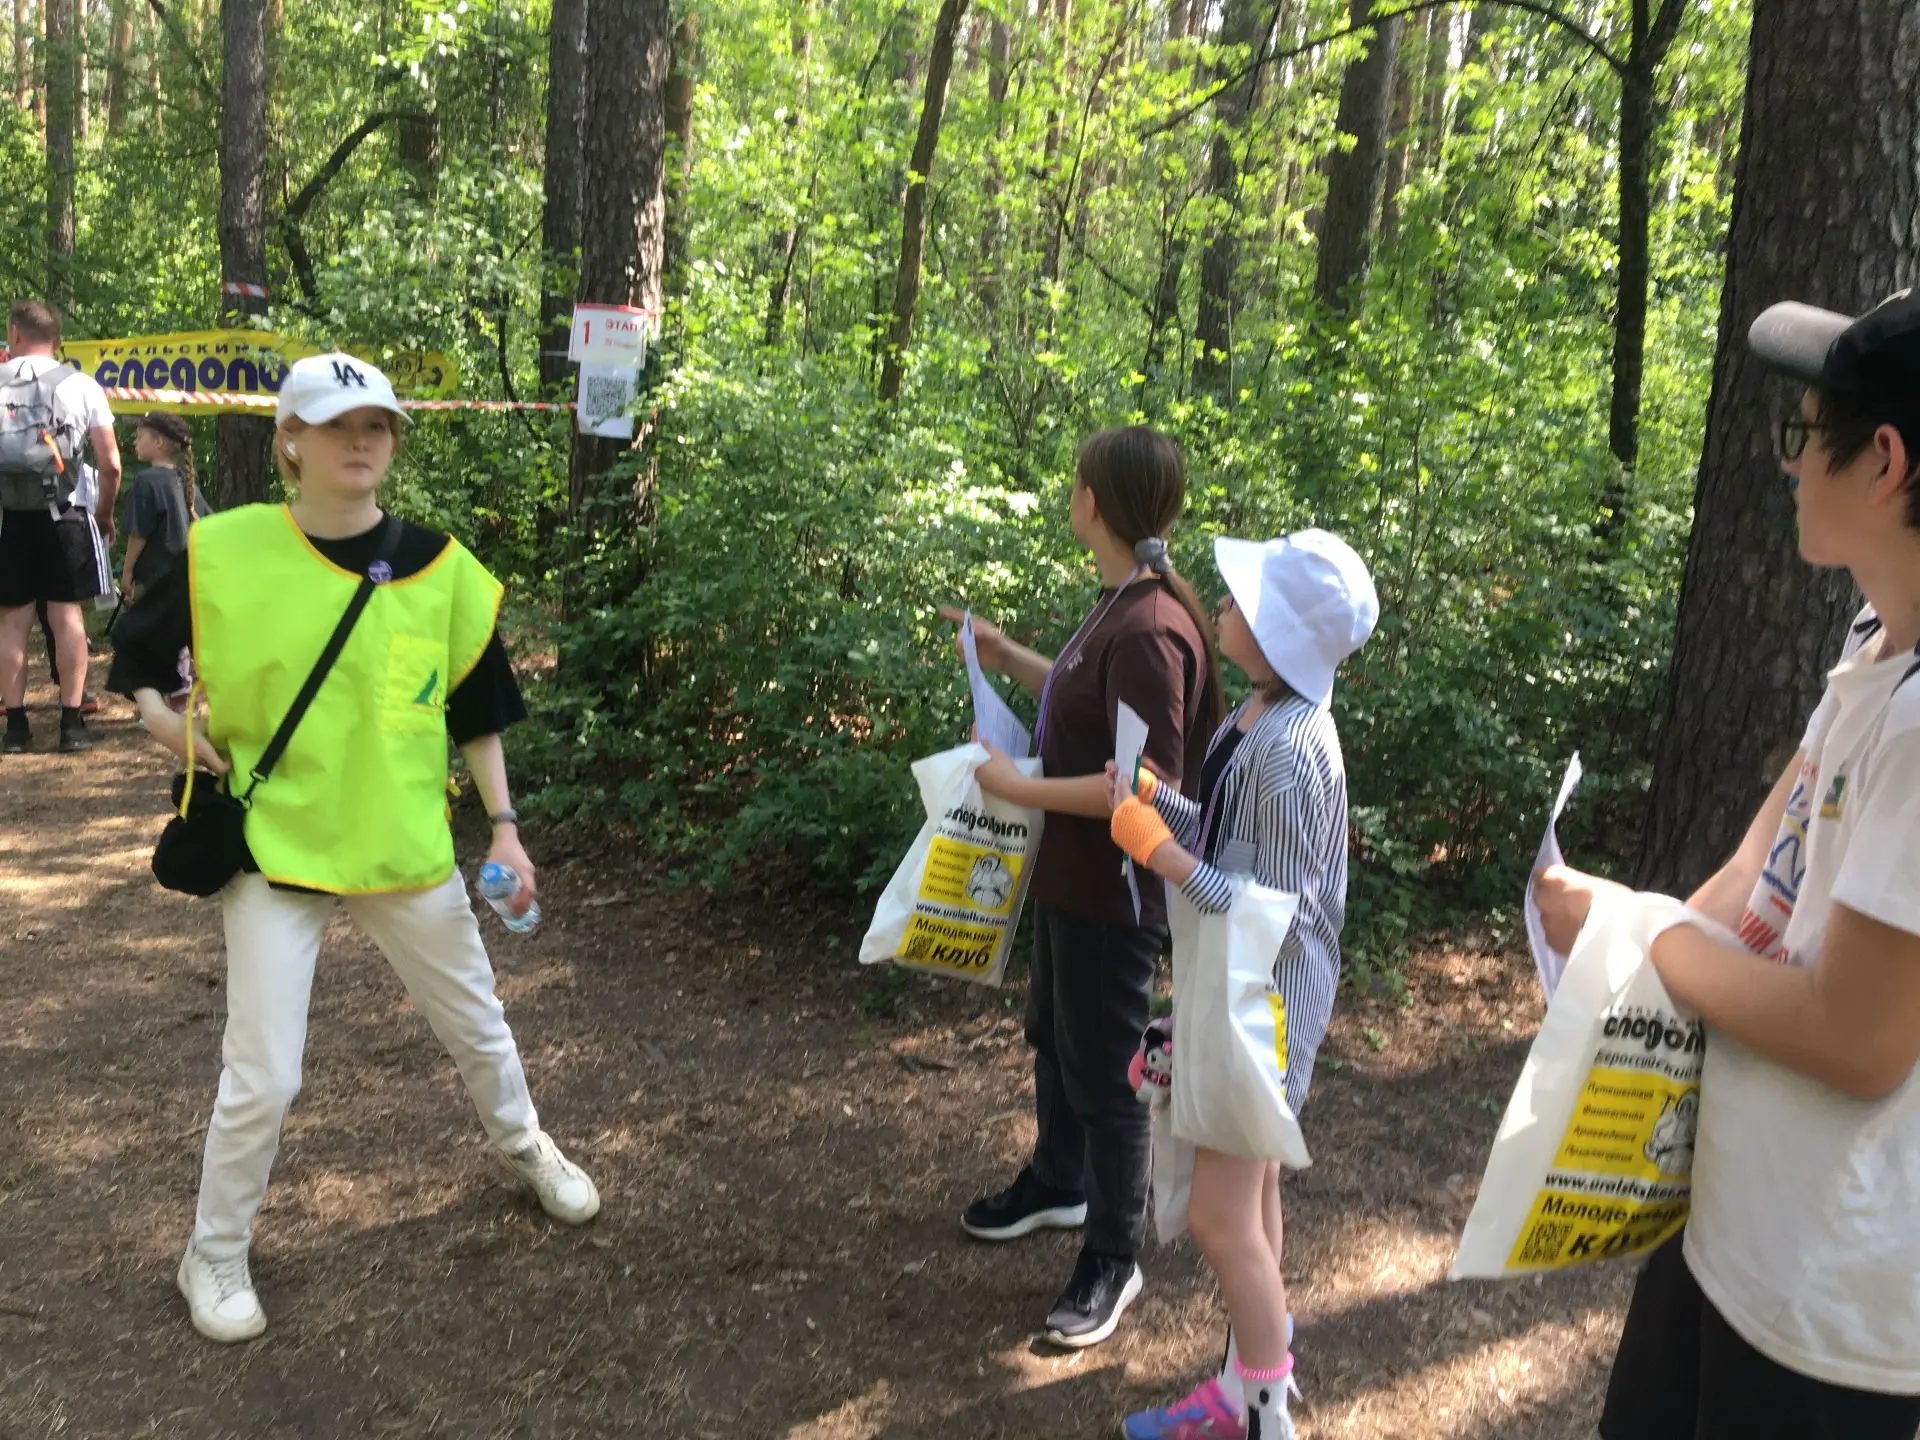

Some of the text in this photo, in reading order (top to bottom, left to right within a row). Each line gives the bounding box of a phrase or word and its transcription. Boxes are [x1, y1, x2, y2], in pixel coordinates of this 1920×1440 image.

[584, 320, 591, 345] 1
[95, 351, 290, 393] следопы
[931, 943, 993, 969] клуб
